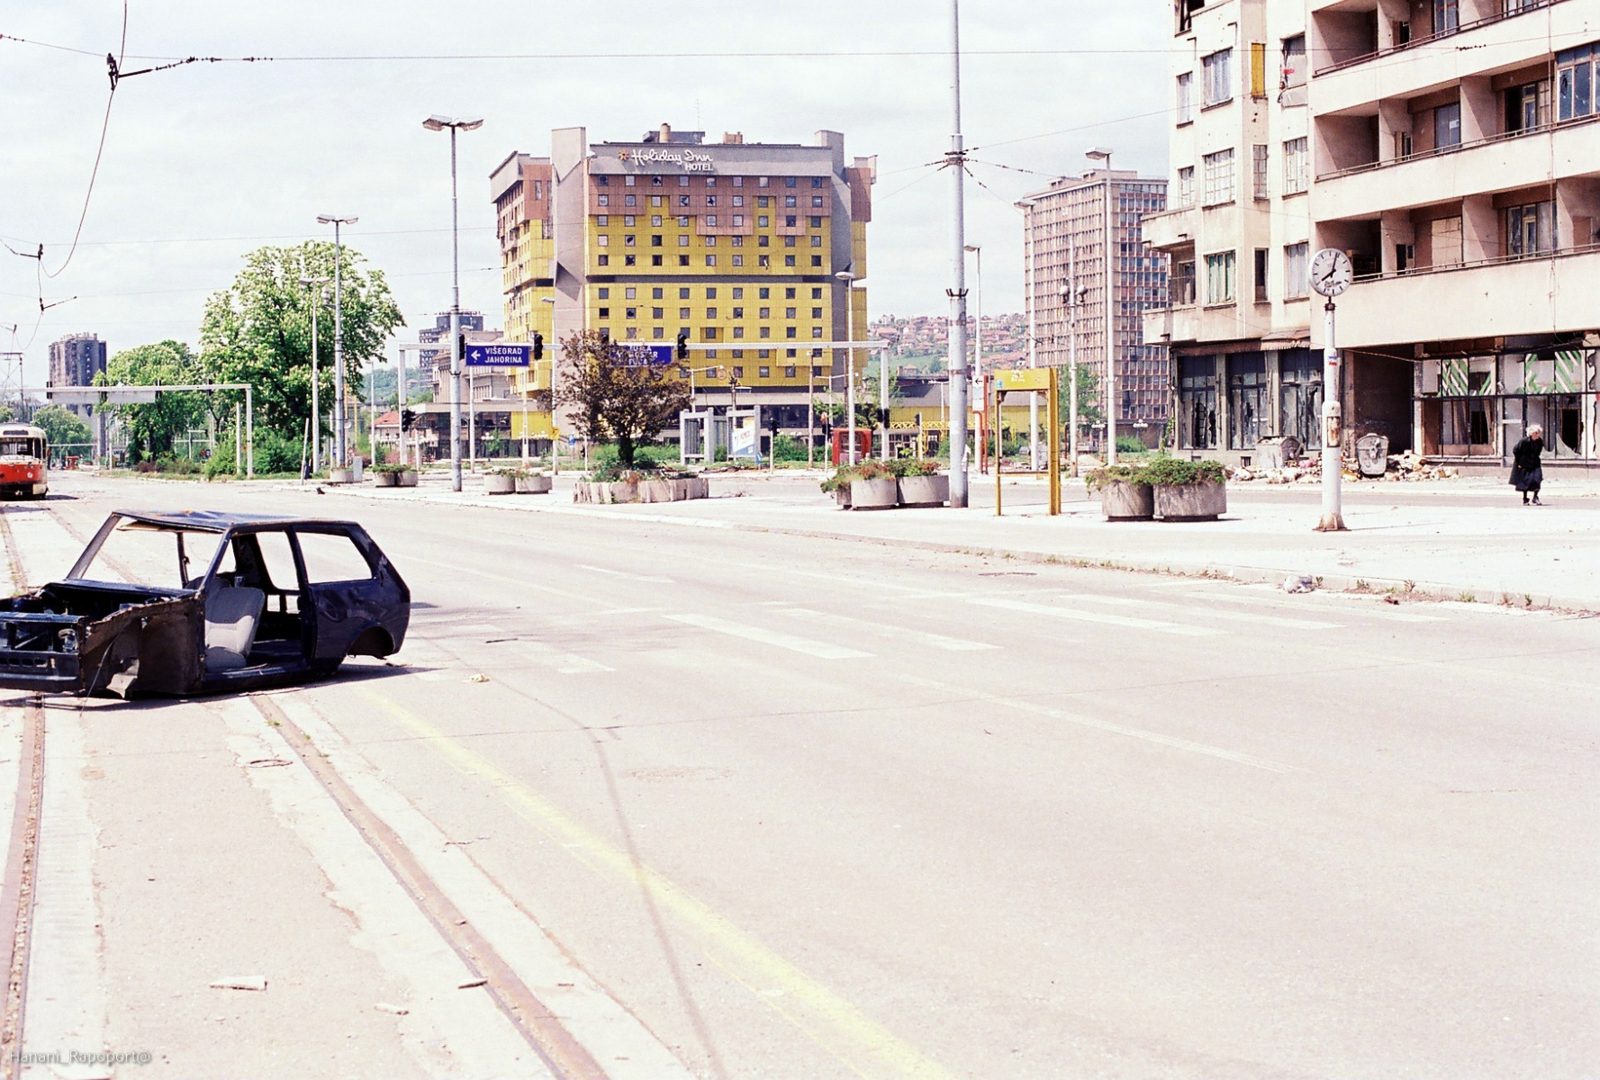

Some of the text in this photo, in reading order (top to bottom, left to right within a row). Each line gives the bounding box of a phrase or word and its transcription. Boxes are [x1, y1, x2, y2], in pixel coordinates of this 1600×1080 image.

[631, 148, 713, 166] Holiday Inn
[685, 163, 713, 171] HOTEL
[485, 356, 523, 364] JAHORINA
